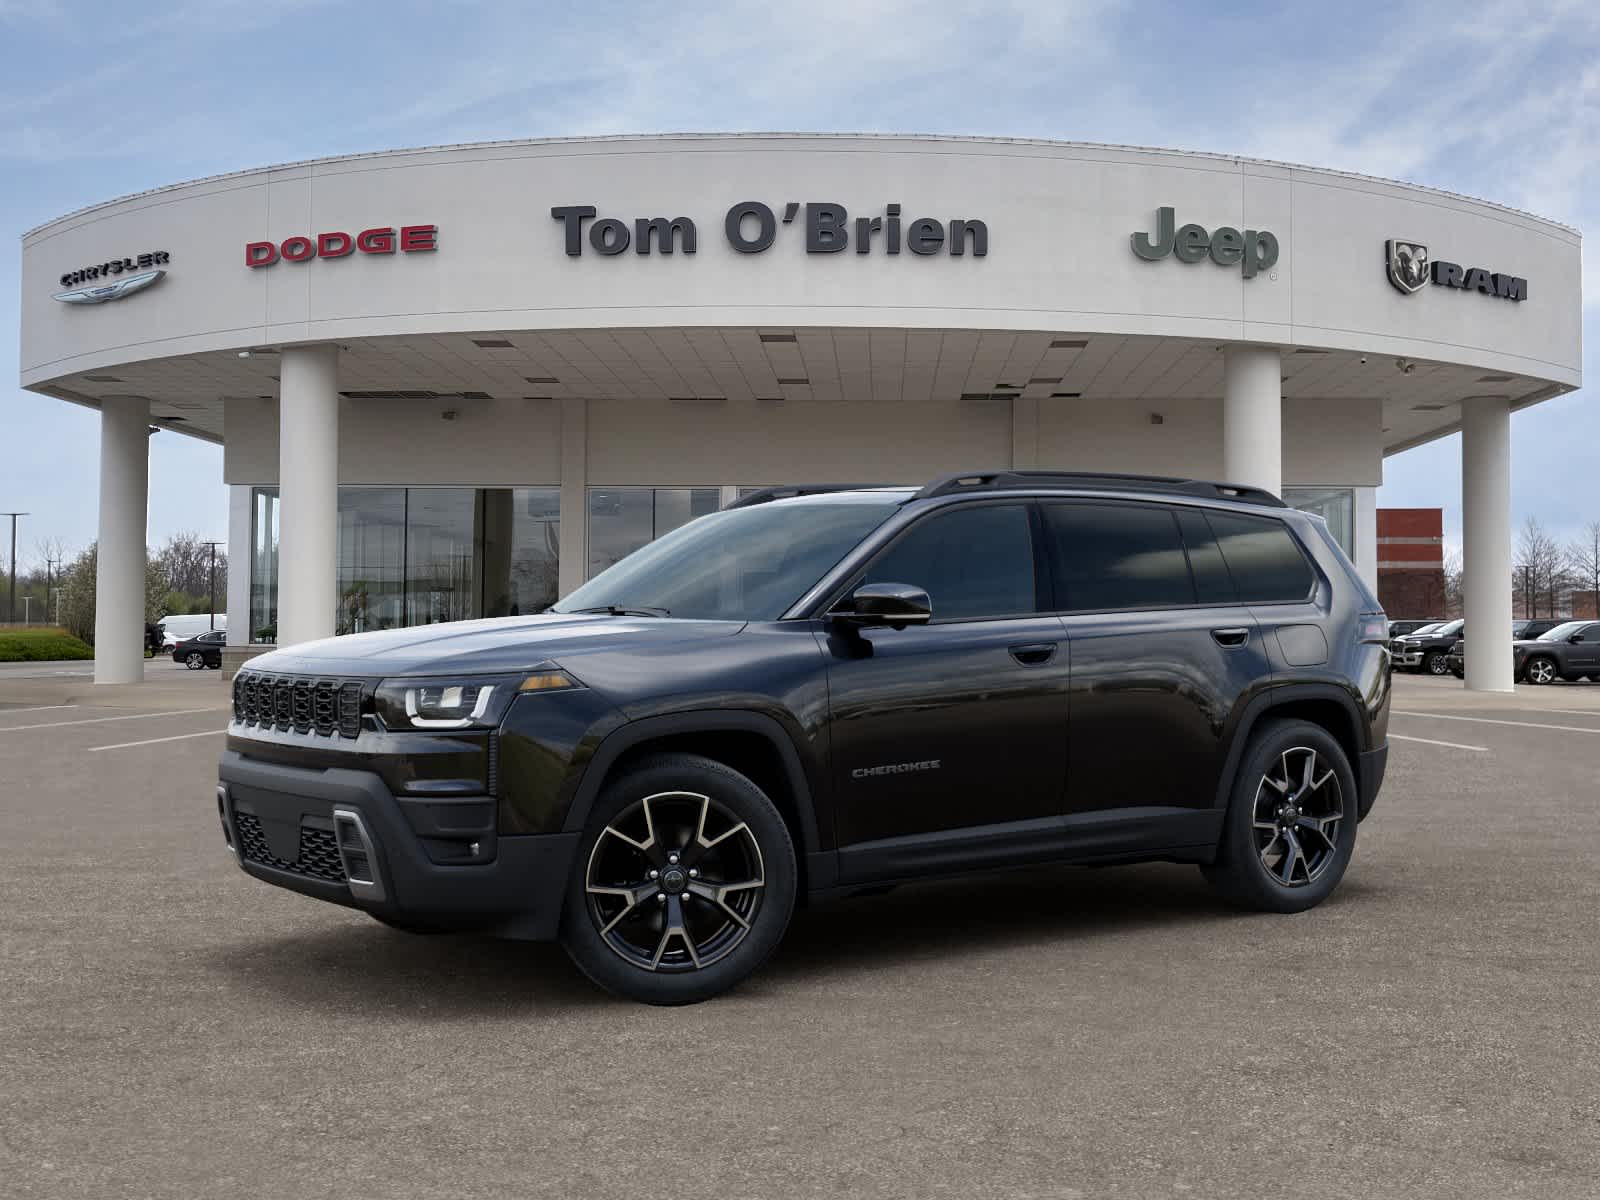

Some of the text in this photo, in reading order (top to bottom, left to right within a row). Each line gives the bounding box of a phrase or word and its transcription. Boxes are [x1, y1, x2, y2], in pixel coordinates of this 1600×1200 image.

[246, 225, 438, 268] DODGE
[551, 206, 696, 256] Tom
[1131, 206, 1279, 279] Jeep
[60, 250, 170, 287] CHRYSLER
[1431, 261, 1528, 302] RAM
